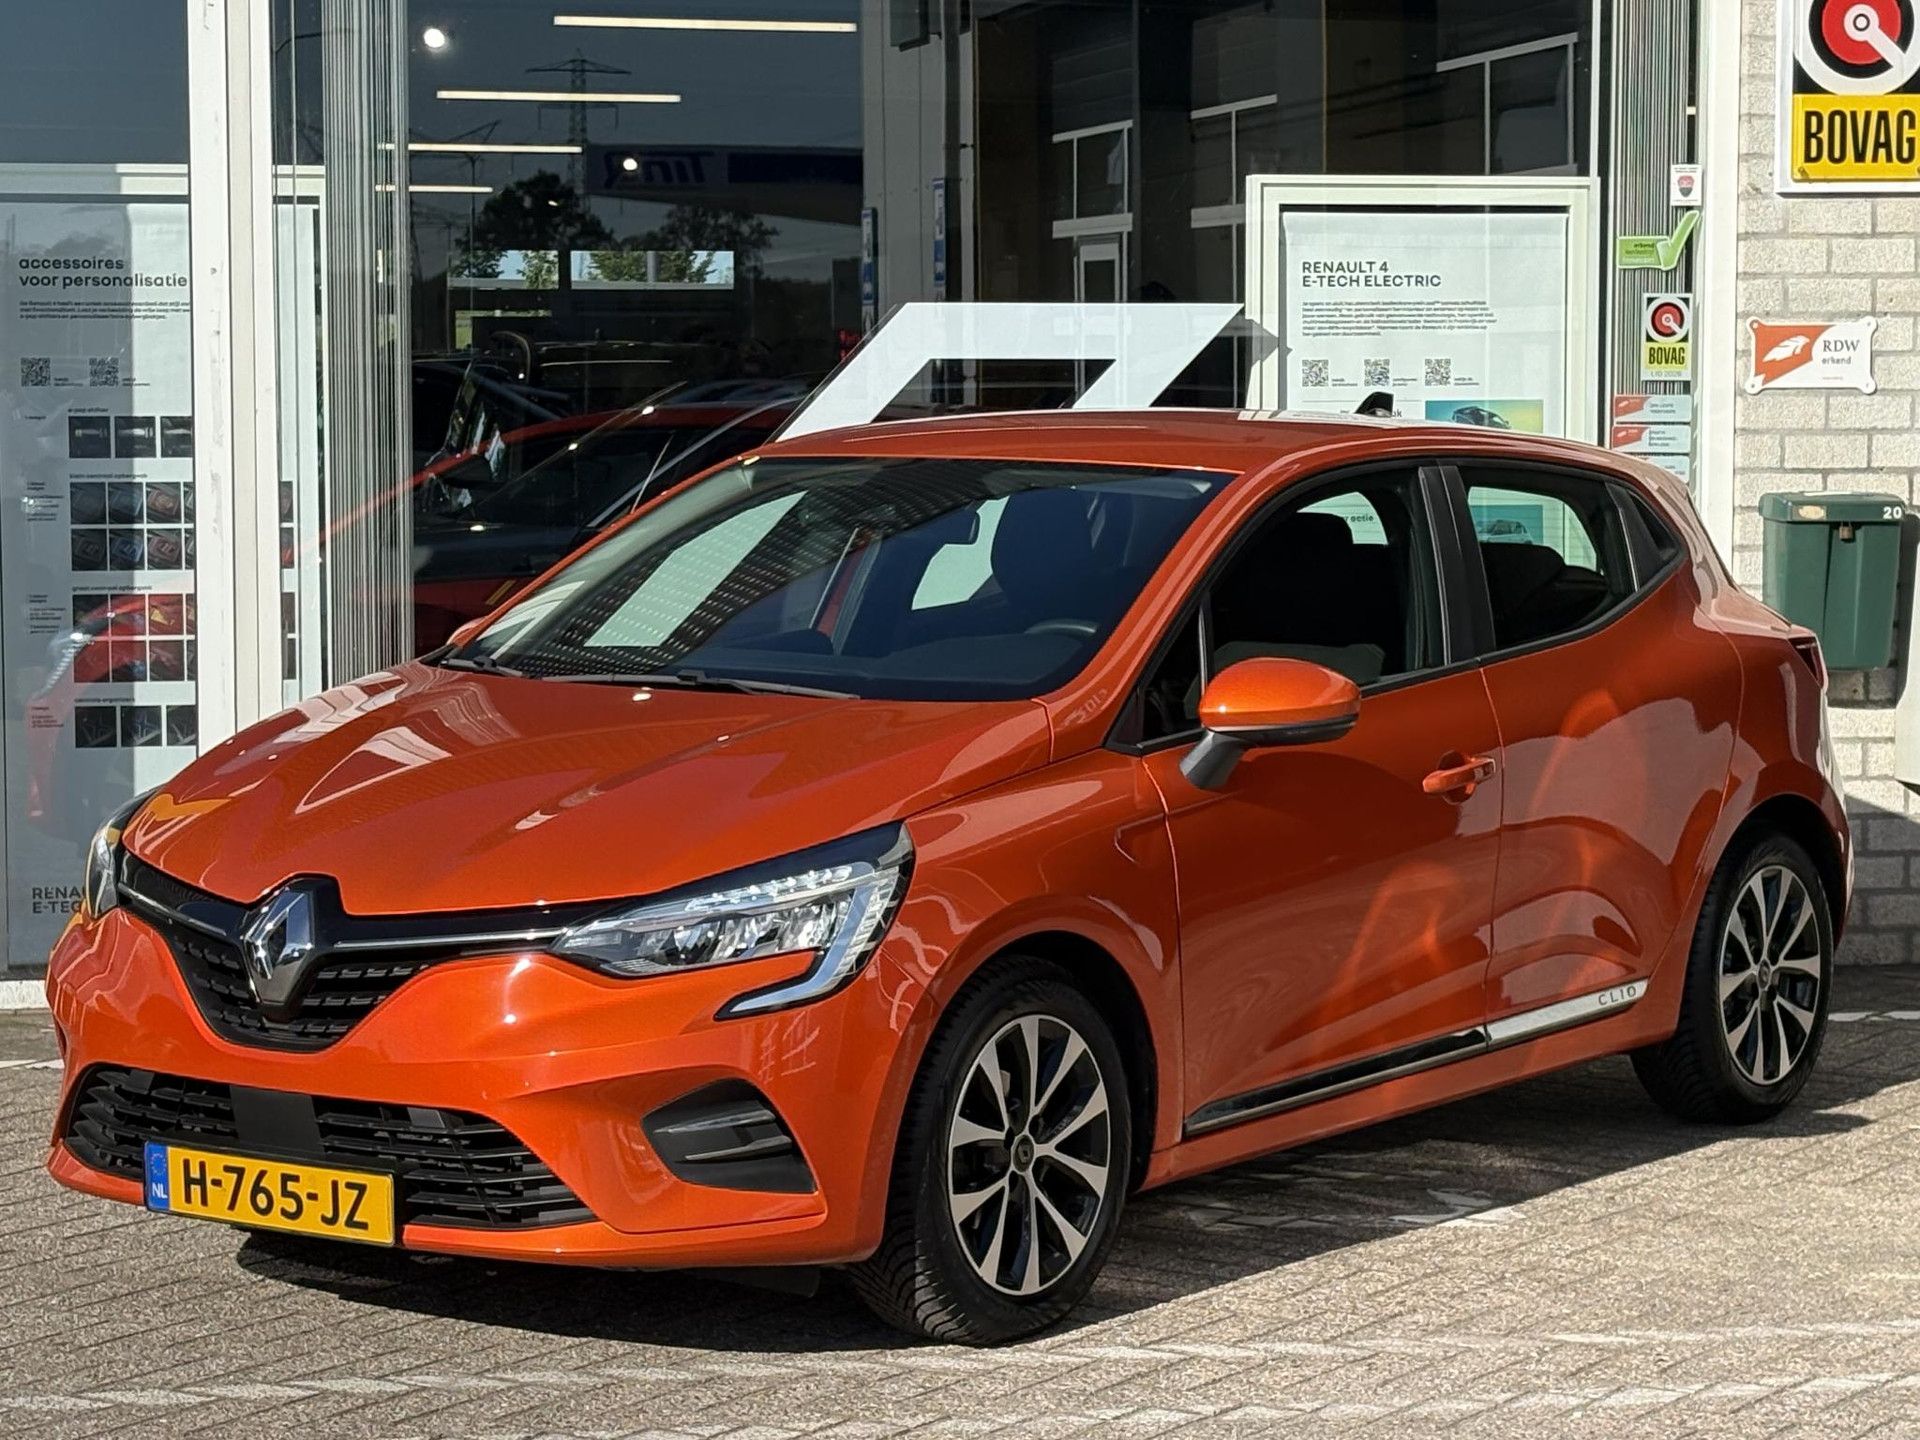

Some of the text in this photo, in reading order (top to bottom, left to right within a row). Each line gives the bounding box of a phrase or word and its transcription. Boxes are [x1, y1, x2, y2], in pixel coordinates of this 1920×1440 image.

[1804, 109, 1917, 165] BOVAG
[19, 256, 125, 270] accessoires
[1302, 261, 1389, 274] RENAULT 4
[19, 273, 188, 290] voor personalisatie
[1302, 275, 1442, 288] E-TECH ELECTRIC
[1822, 339, 1860, 353] RDW
[1648, 346, 1686, 365] BOVAG
[1821, 356, 1852, 365] erkend
[1882, 506, 1902, 519] 20
[1598, 985, 1637, 1006] CLIO
[151, 1183, 168, 1199] NL
[181, 1158, 369, 1231] H-765-JZ
